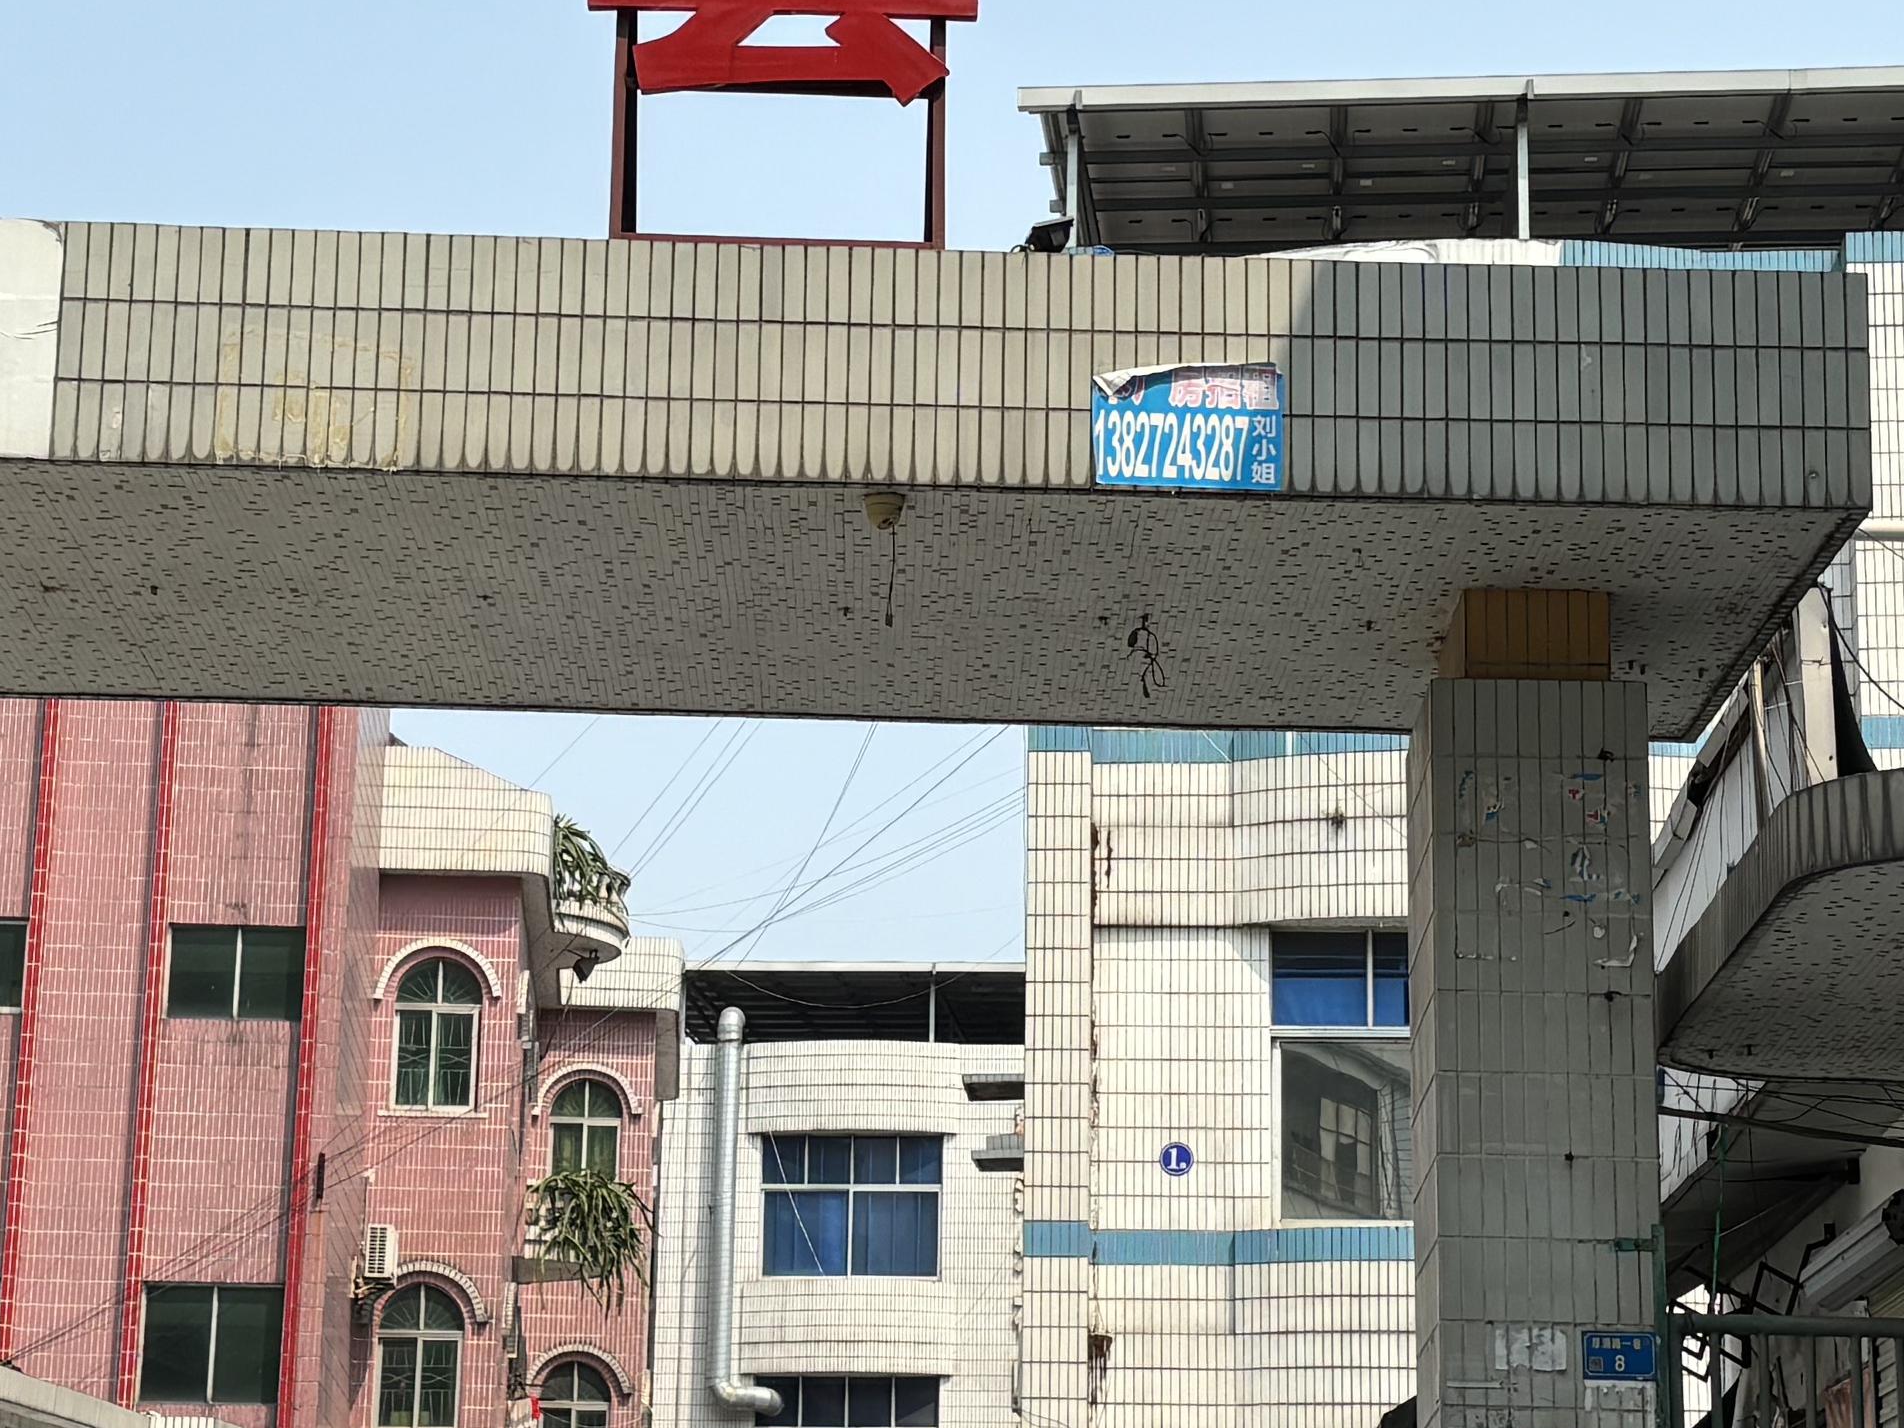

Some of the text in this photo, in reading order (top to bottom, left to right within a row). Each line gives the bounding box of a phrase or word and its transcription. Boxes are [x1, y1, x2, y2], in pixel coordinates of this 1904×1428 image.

[1095, 409, 1250, 482] 13827243287
[1251, 415, 1277, 484] 刘小姐
[1614, 1354, 1625, 1372] 8
